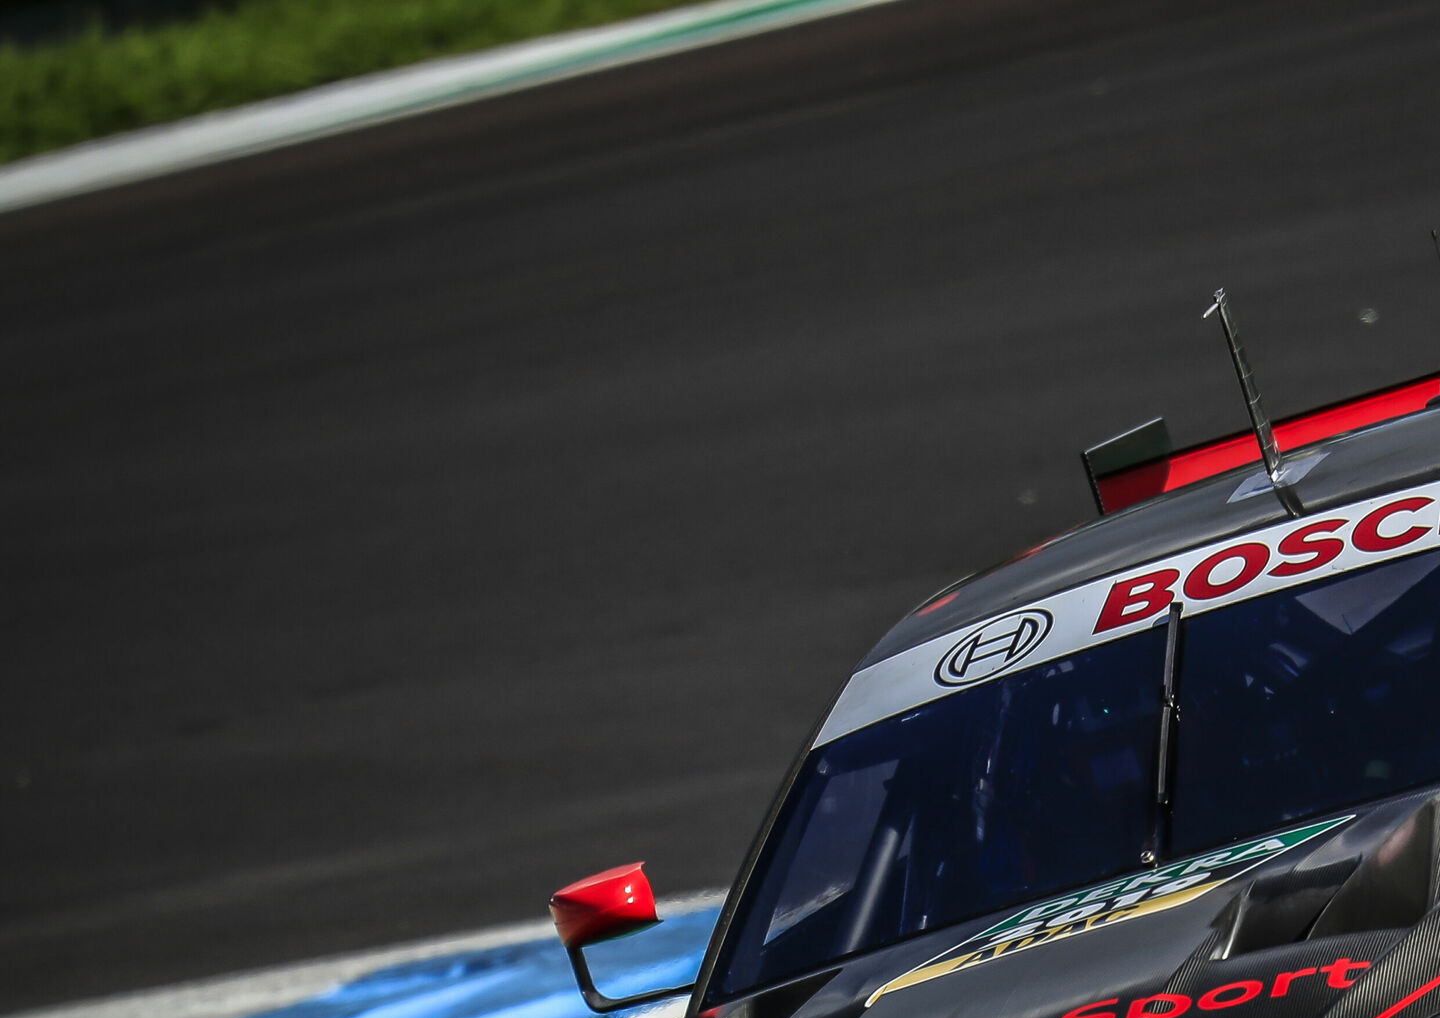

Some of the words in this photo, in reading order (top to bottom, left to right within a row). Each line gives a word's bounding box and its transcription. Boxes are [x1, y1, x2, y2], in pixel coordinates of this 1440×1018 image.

[987, 871, 1212, 943] 2019
[1020, 838, 1286, 922] DEKRA
[953, 906, 1139, 970] ADAC
